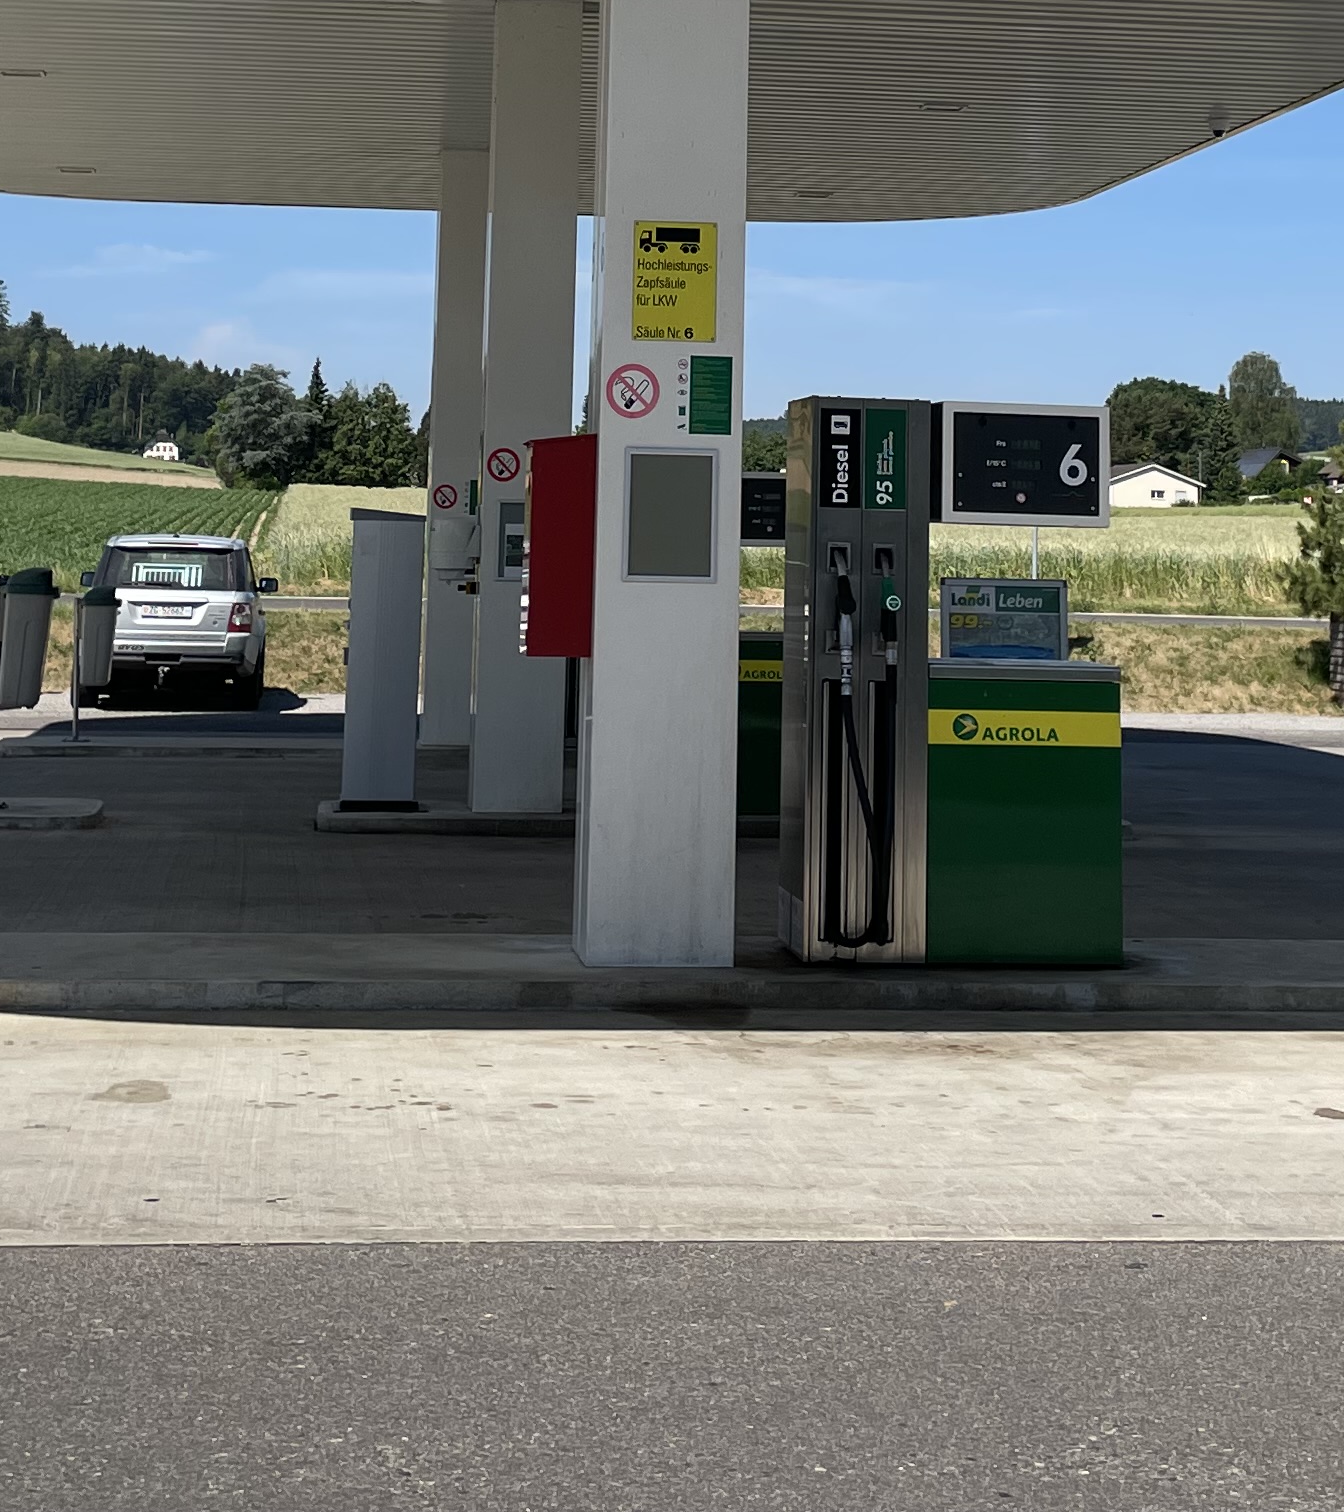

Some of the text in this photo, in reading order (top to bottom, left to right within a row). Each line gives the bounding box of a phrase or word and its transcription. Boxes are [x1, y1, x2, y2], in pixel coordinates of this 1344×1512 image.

[637, 258, 713, 274] Hochleistungs-
[636, 276, 686, 291] Zapfsäule
[636, 294, 678, 306] für LKW
[636, 326, 665, 338] Säule
[684, 327, 694, 339] 6
[1059, 444, 1088, 486] 6
[832, 445, 849, 503] Diesel
[876, 481, 893, 505] 95
[999, 593, 1043, 608] Leben
[743, 670, 783, 679] AGROL
[982, 727, 1059, 742] AGROLA
